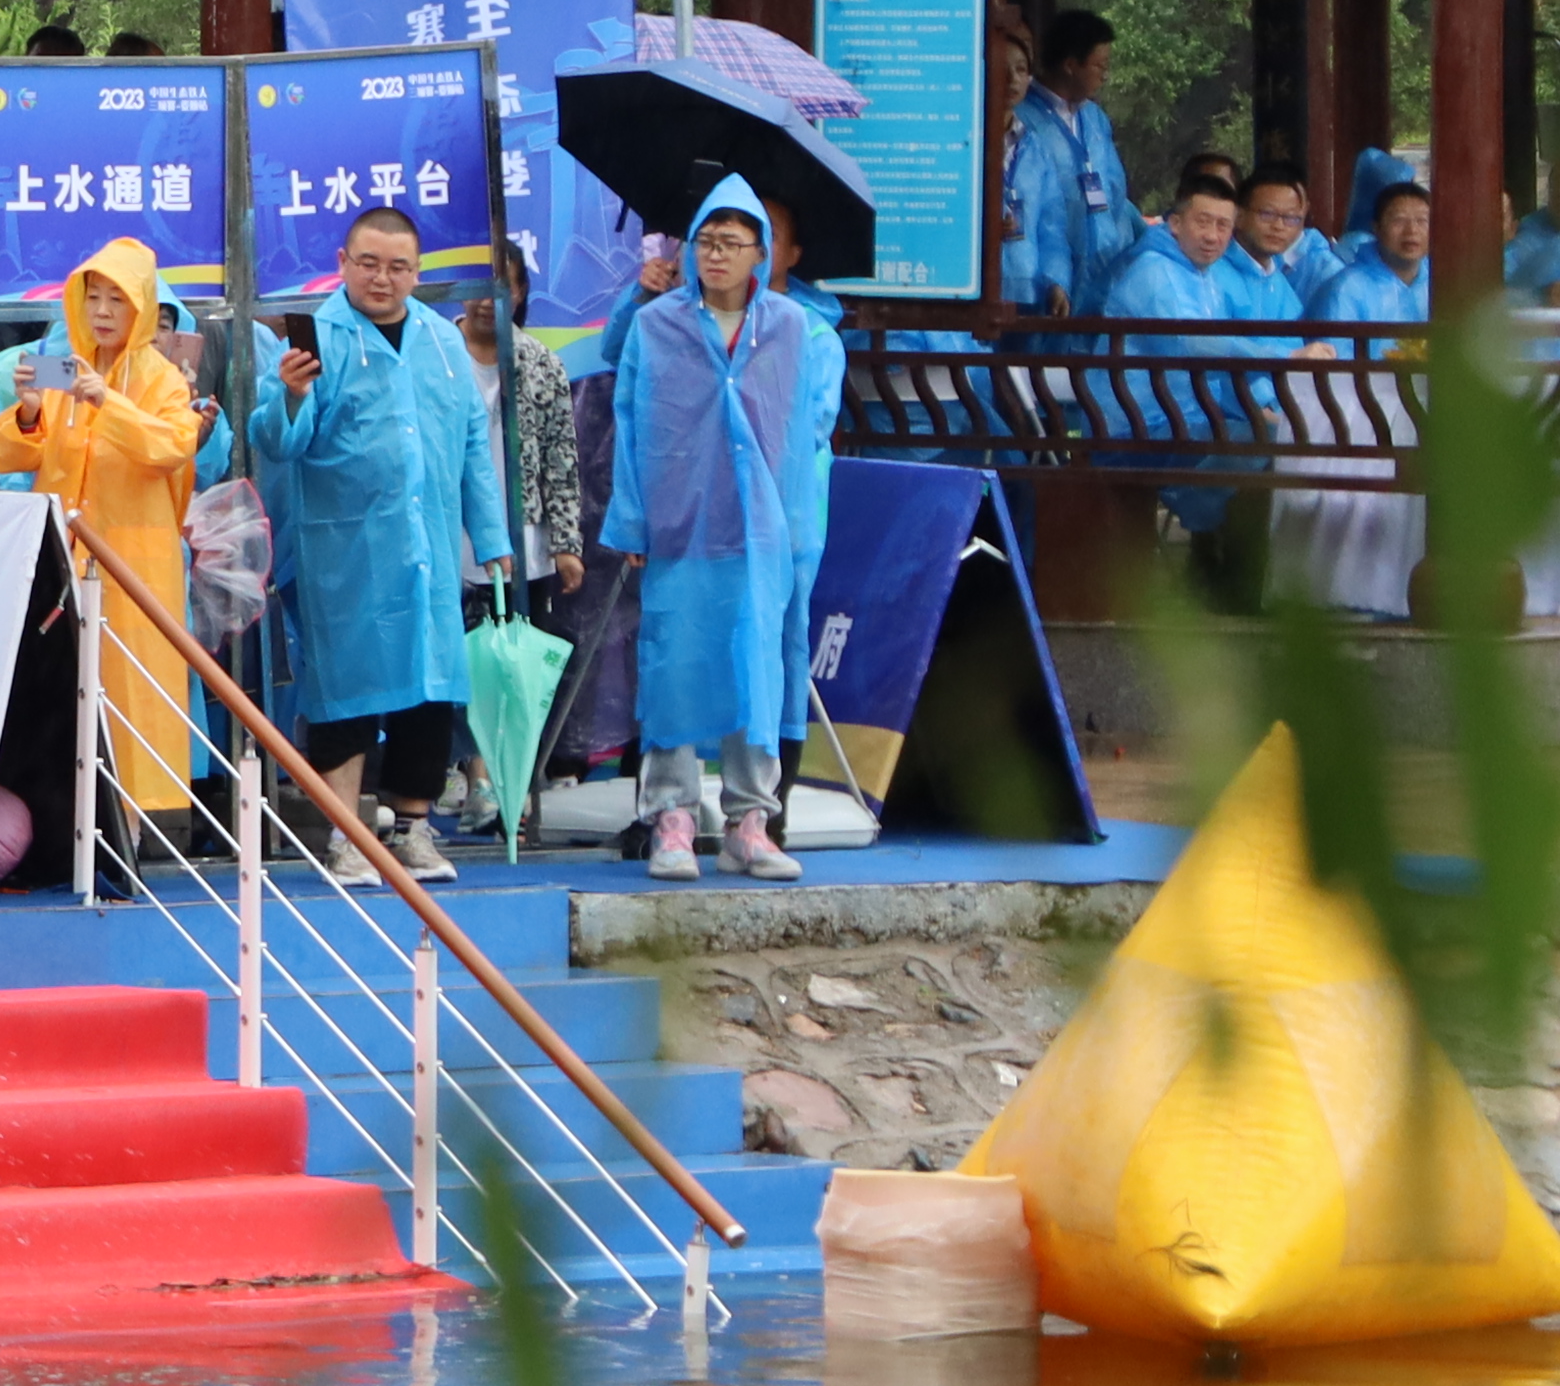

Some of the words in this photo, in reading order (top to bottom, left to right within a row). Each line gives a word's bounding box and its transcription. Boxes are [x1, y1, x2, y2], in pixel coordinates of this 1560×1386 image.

[99, 87, 145, 110] 2023
[361, 75, 405, 101] 2023
[5, 164, 193, 213] 上水通道
[280, 159, 451, 216] 上水平台
[810, 612, 854, 681] 府
